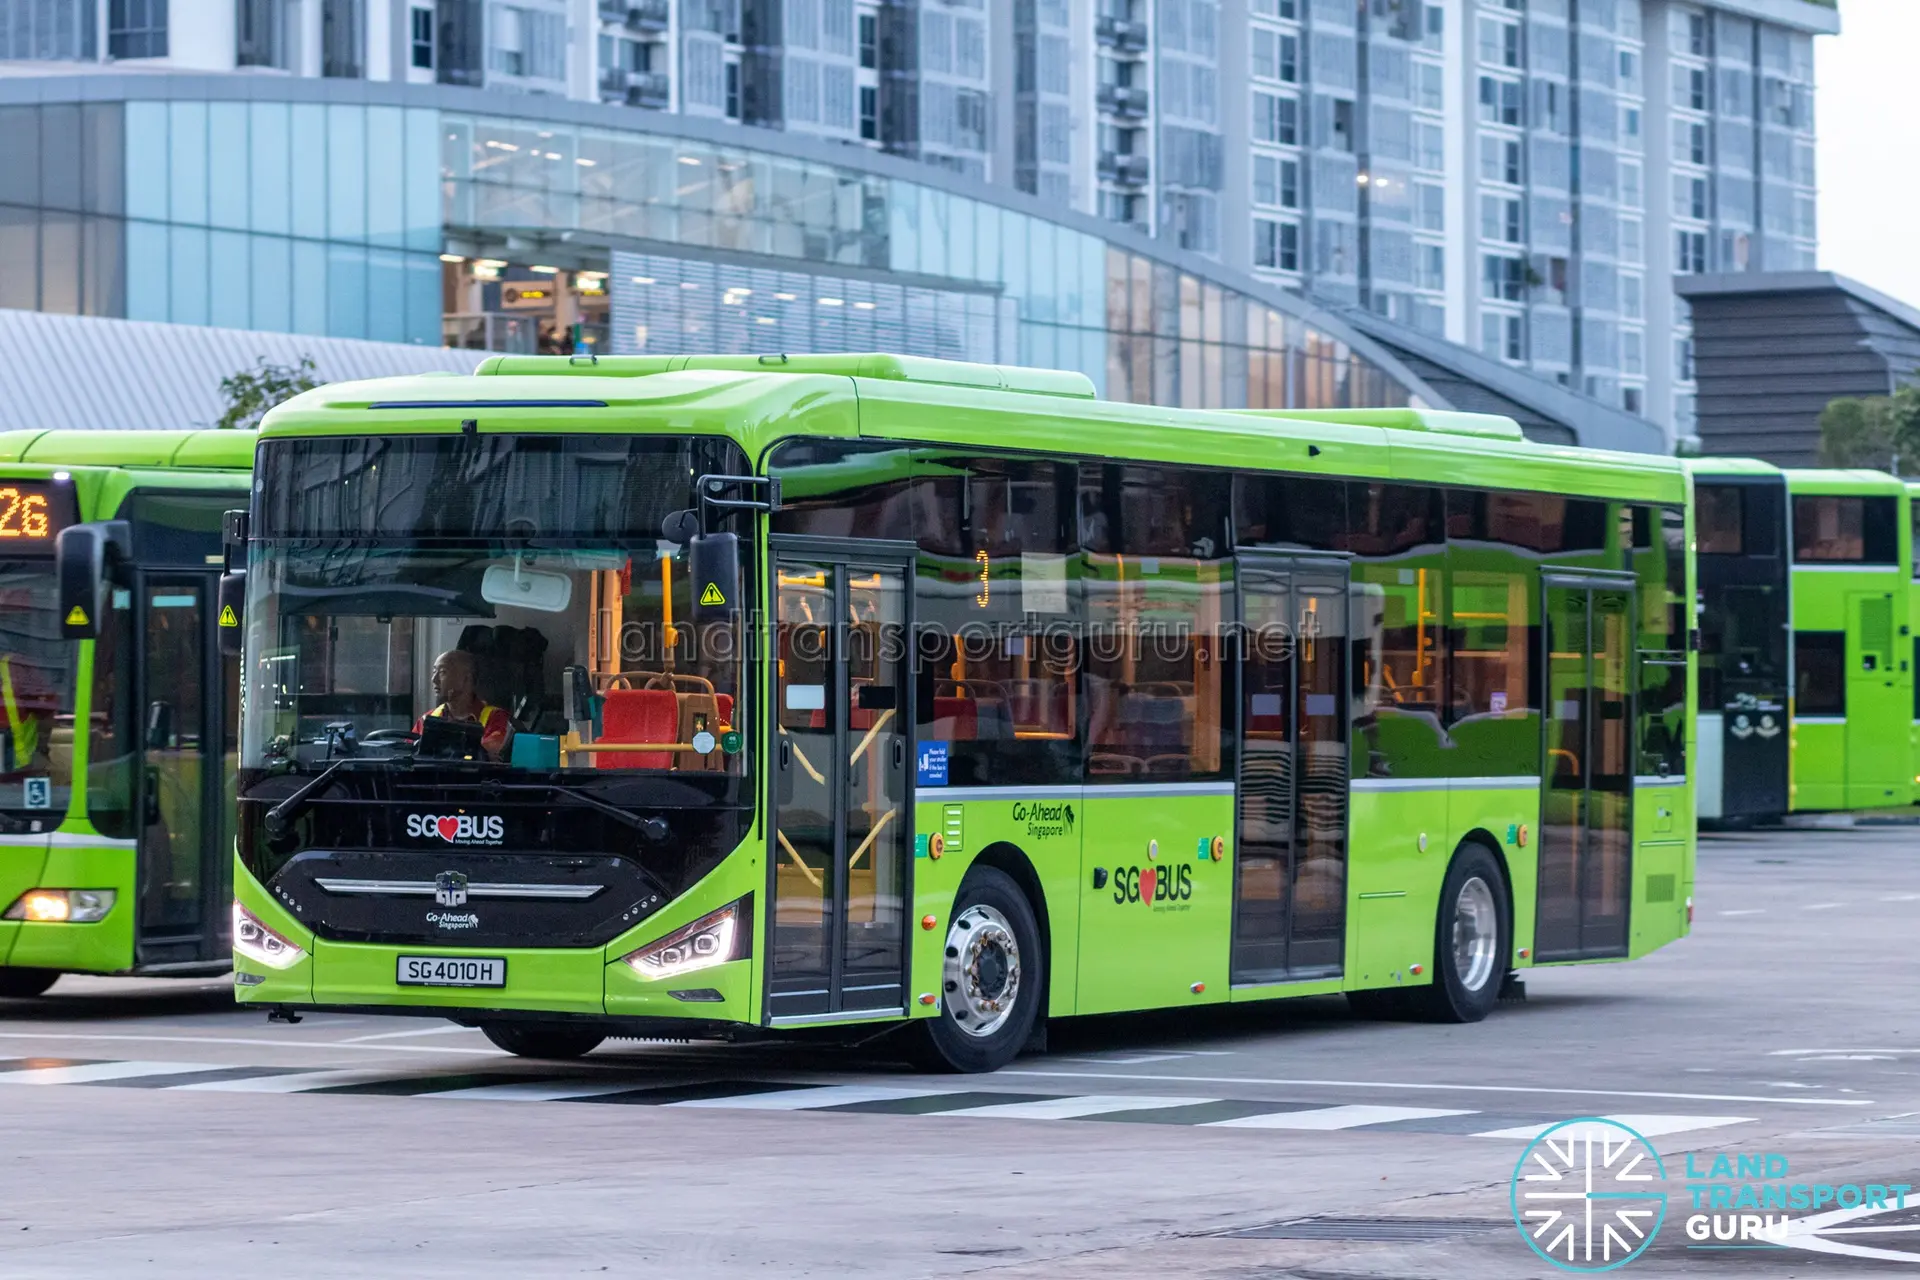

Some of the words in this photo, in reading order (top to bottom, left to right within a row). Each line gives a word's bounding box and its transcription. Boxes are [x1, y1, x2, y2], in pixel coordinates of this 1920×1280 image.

[1012, 802, 1063, 822] Go-Ahead
[1027, 822, 1063, 840] Singapore
[426, 912, 469, 922] Go-Ahead
[438, 921, 469, 930] Singapore
